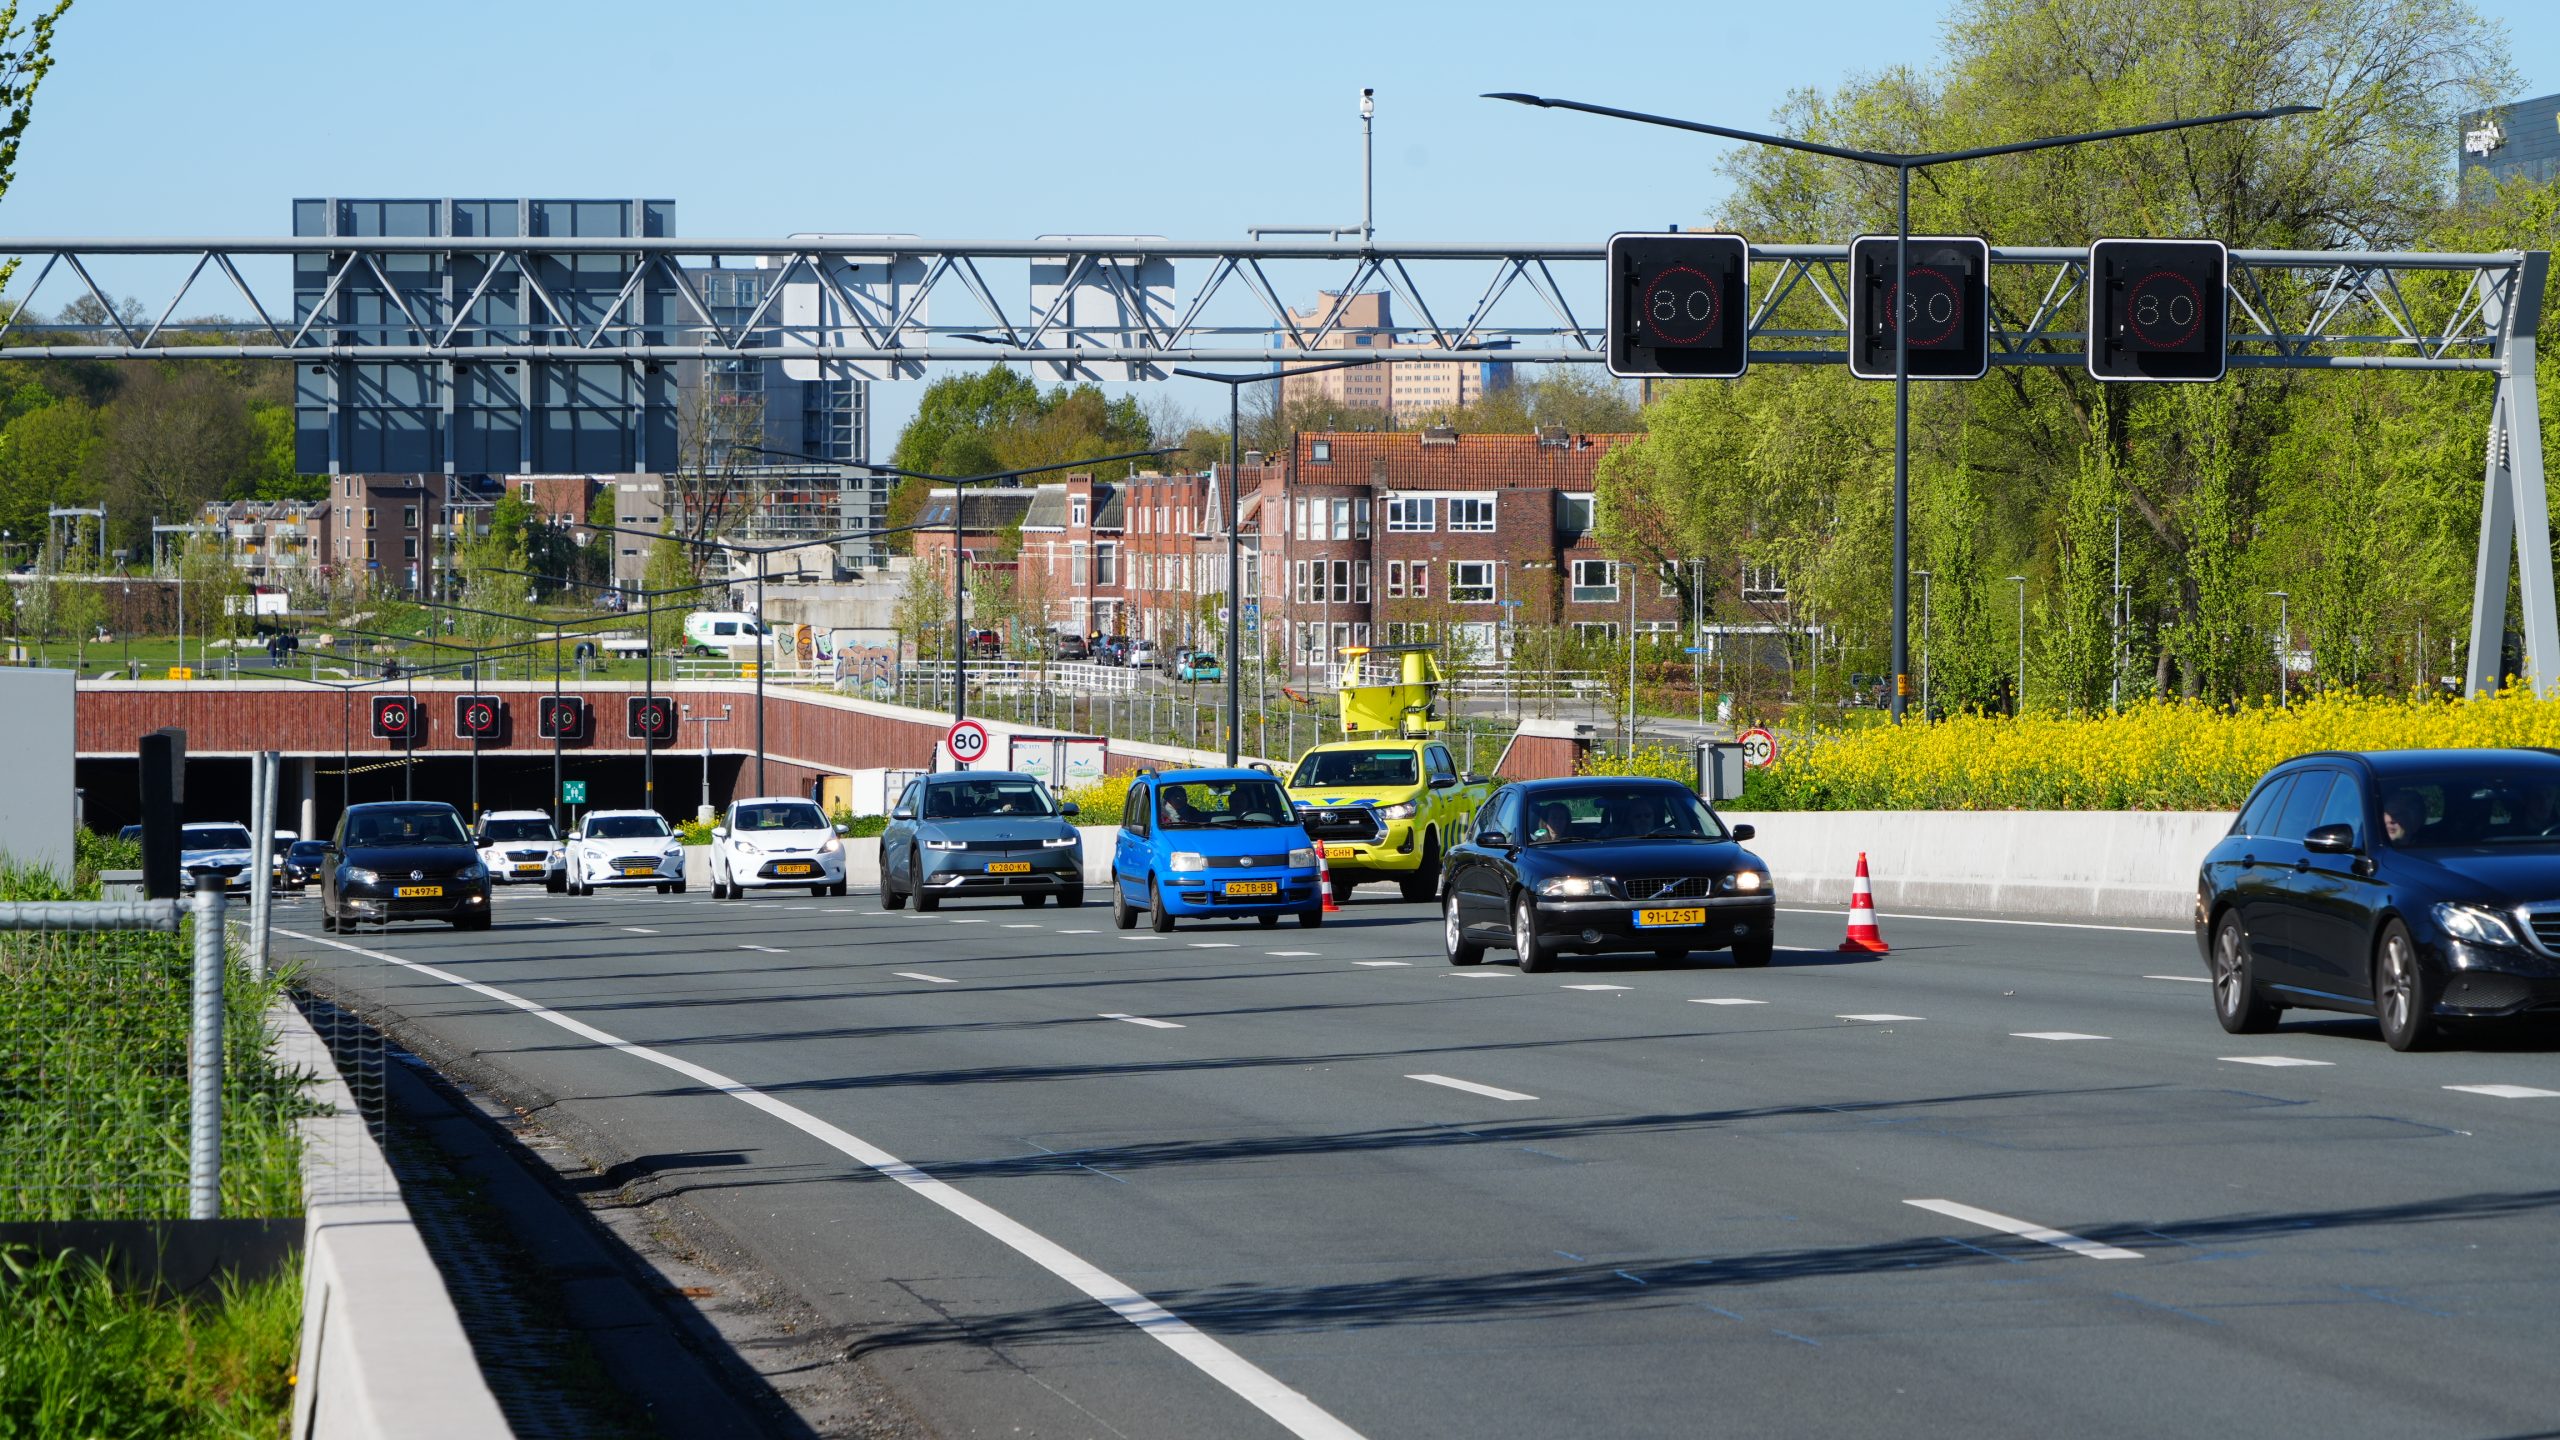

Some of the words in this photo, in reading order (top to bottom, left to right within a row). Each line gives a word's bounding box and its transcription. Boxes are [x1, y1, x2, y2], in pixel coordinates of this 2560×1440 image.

[1653, 290, 1711, 321] 80
[2137, 294, 2194, 325] 80
[384, 712, 405, 724] 80
[468, 711, 489, 724] 80
[954, 733, 982, 750] 80
[779, 864, 808, 873] 38-XPT-2
[990, 863, 1028, 872] X-280-KK
[401, 887, 439, 896] NJ-497-F
[1228, 882, 1273, 893] 62-TB-BB
[1647, 910, 1699, 923] 91-LZ-ST
